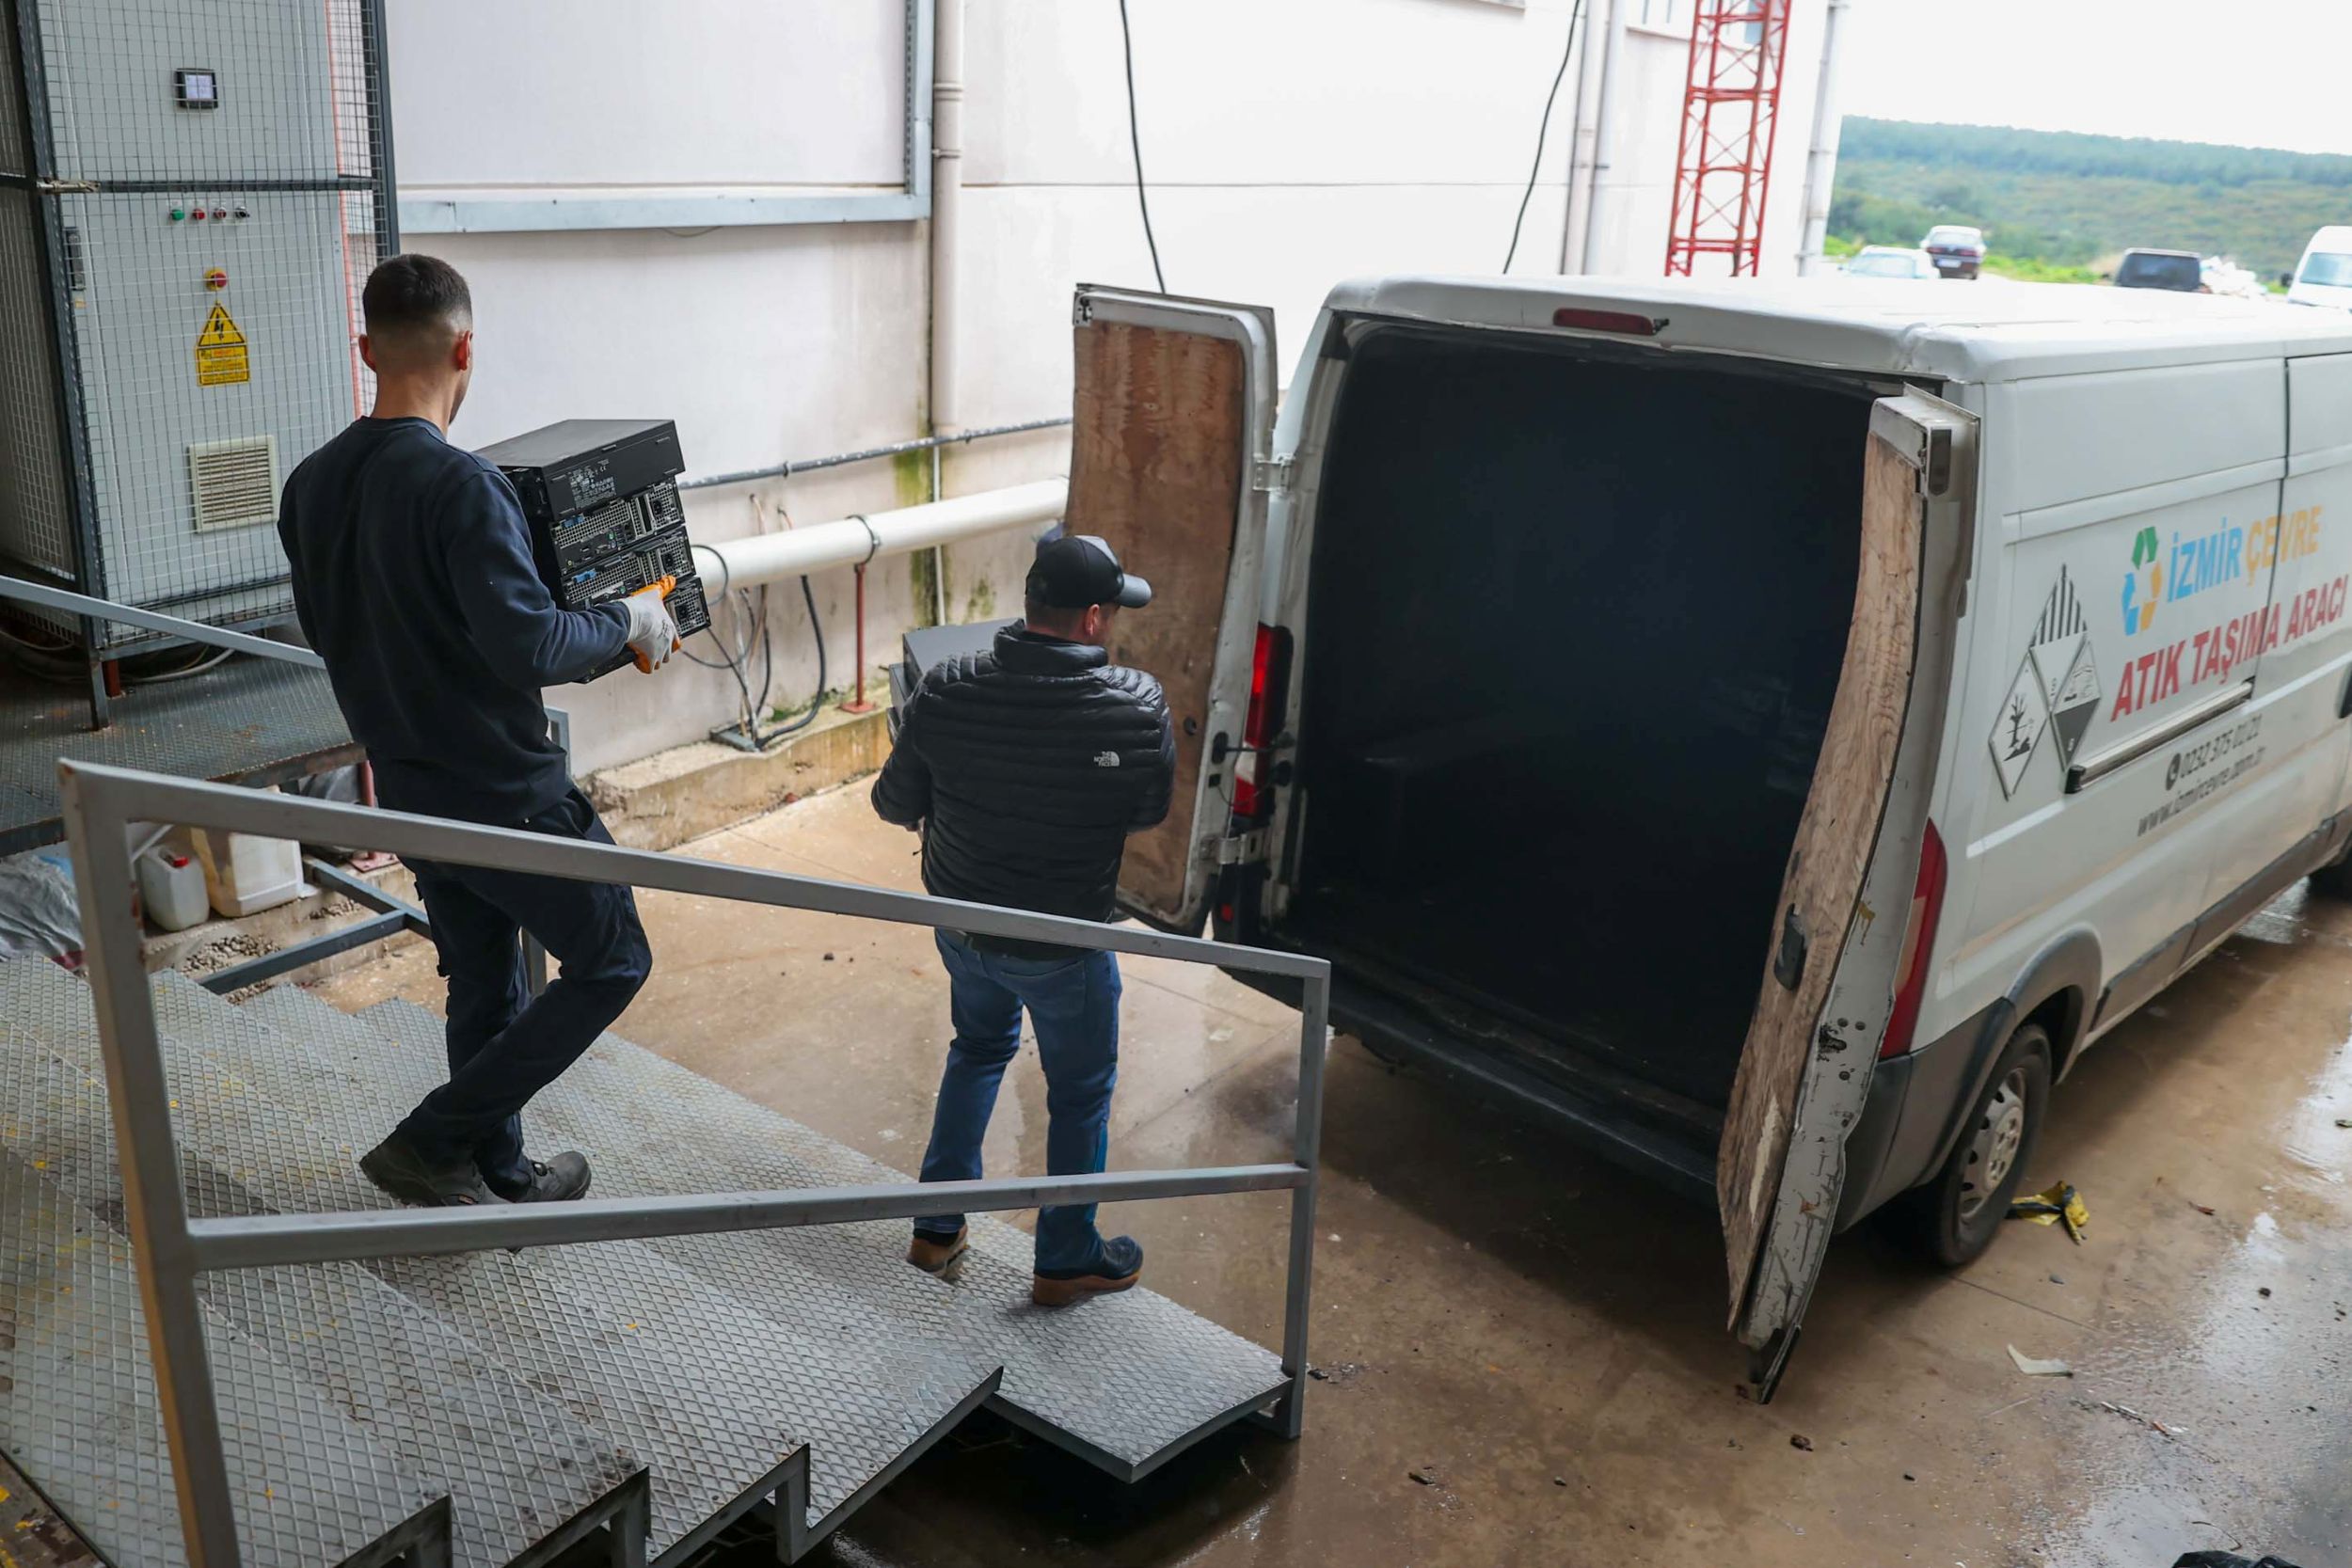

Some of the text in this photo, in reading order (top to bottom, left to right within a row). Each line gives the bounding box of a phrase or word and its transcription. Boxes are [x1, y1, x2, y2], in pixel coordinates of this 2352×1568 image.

[2167, 506, 2321, 603] İZMİR ÇEVRE
[2110, 574, 2349, 722] ATIK TAŞIMA ARACI
[2181, 742, 2210, 778] 0232
